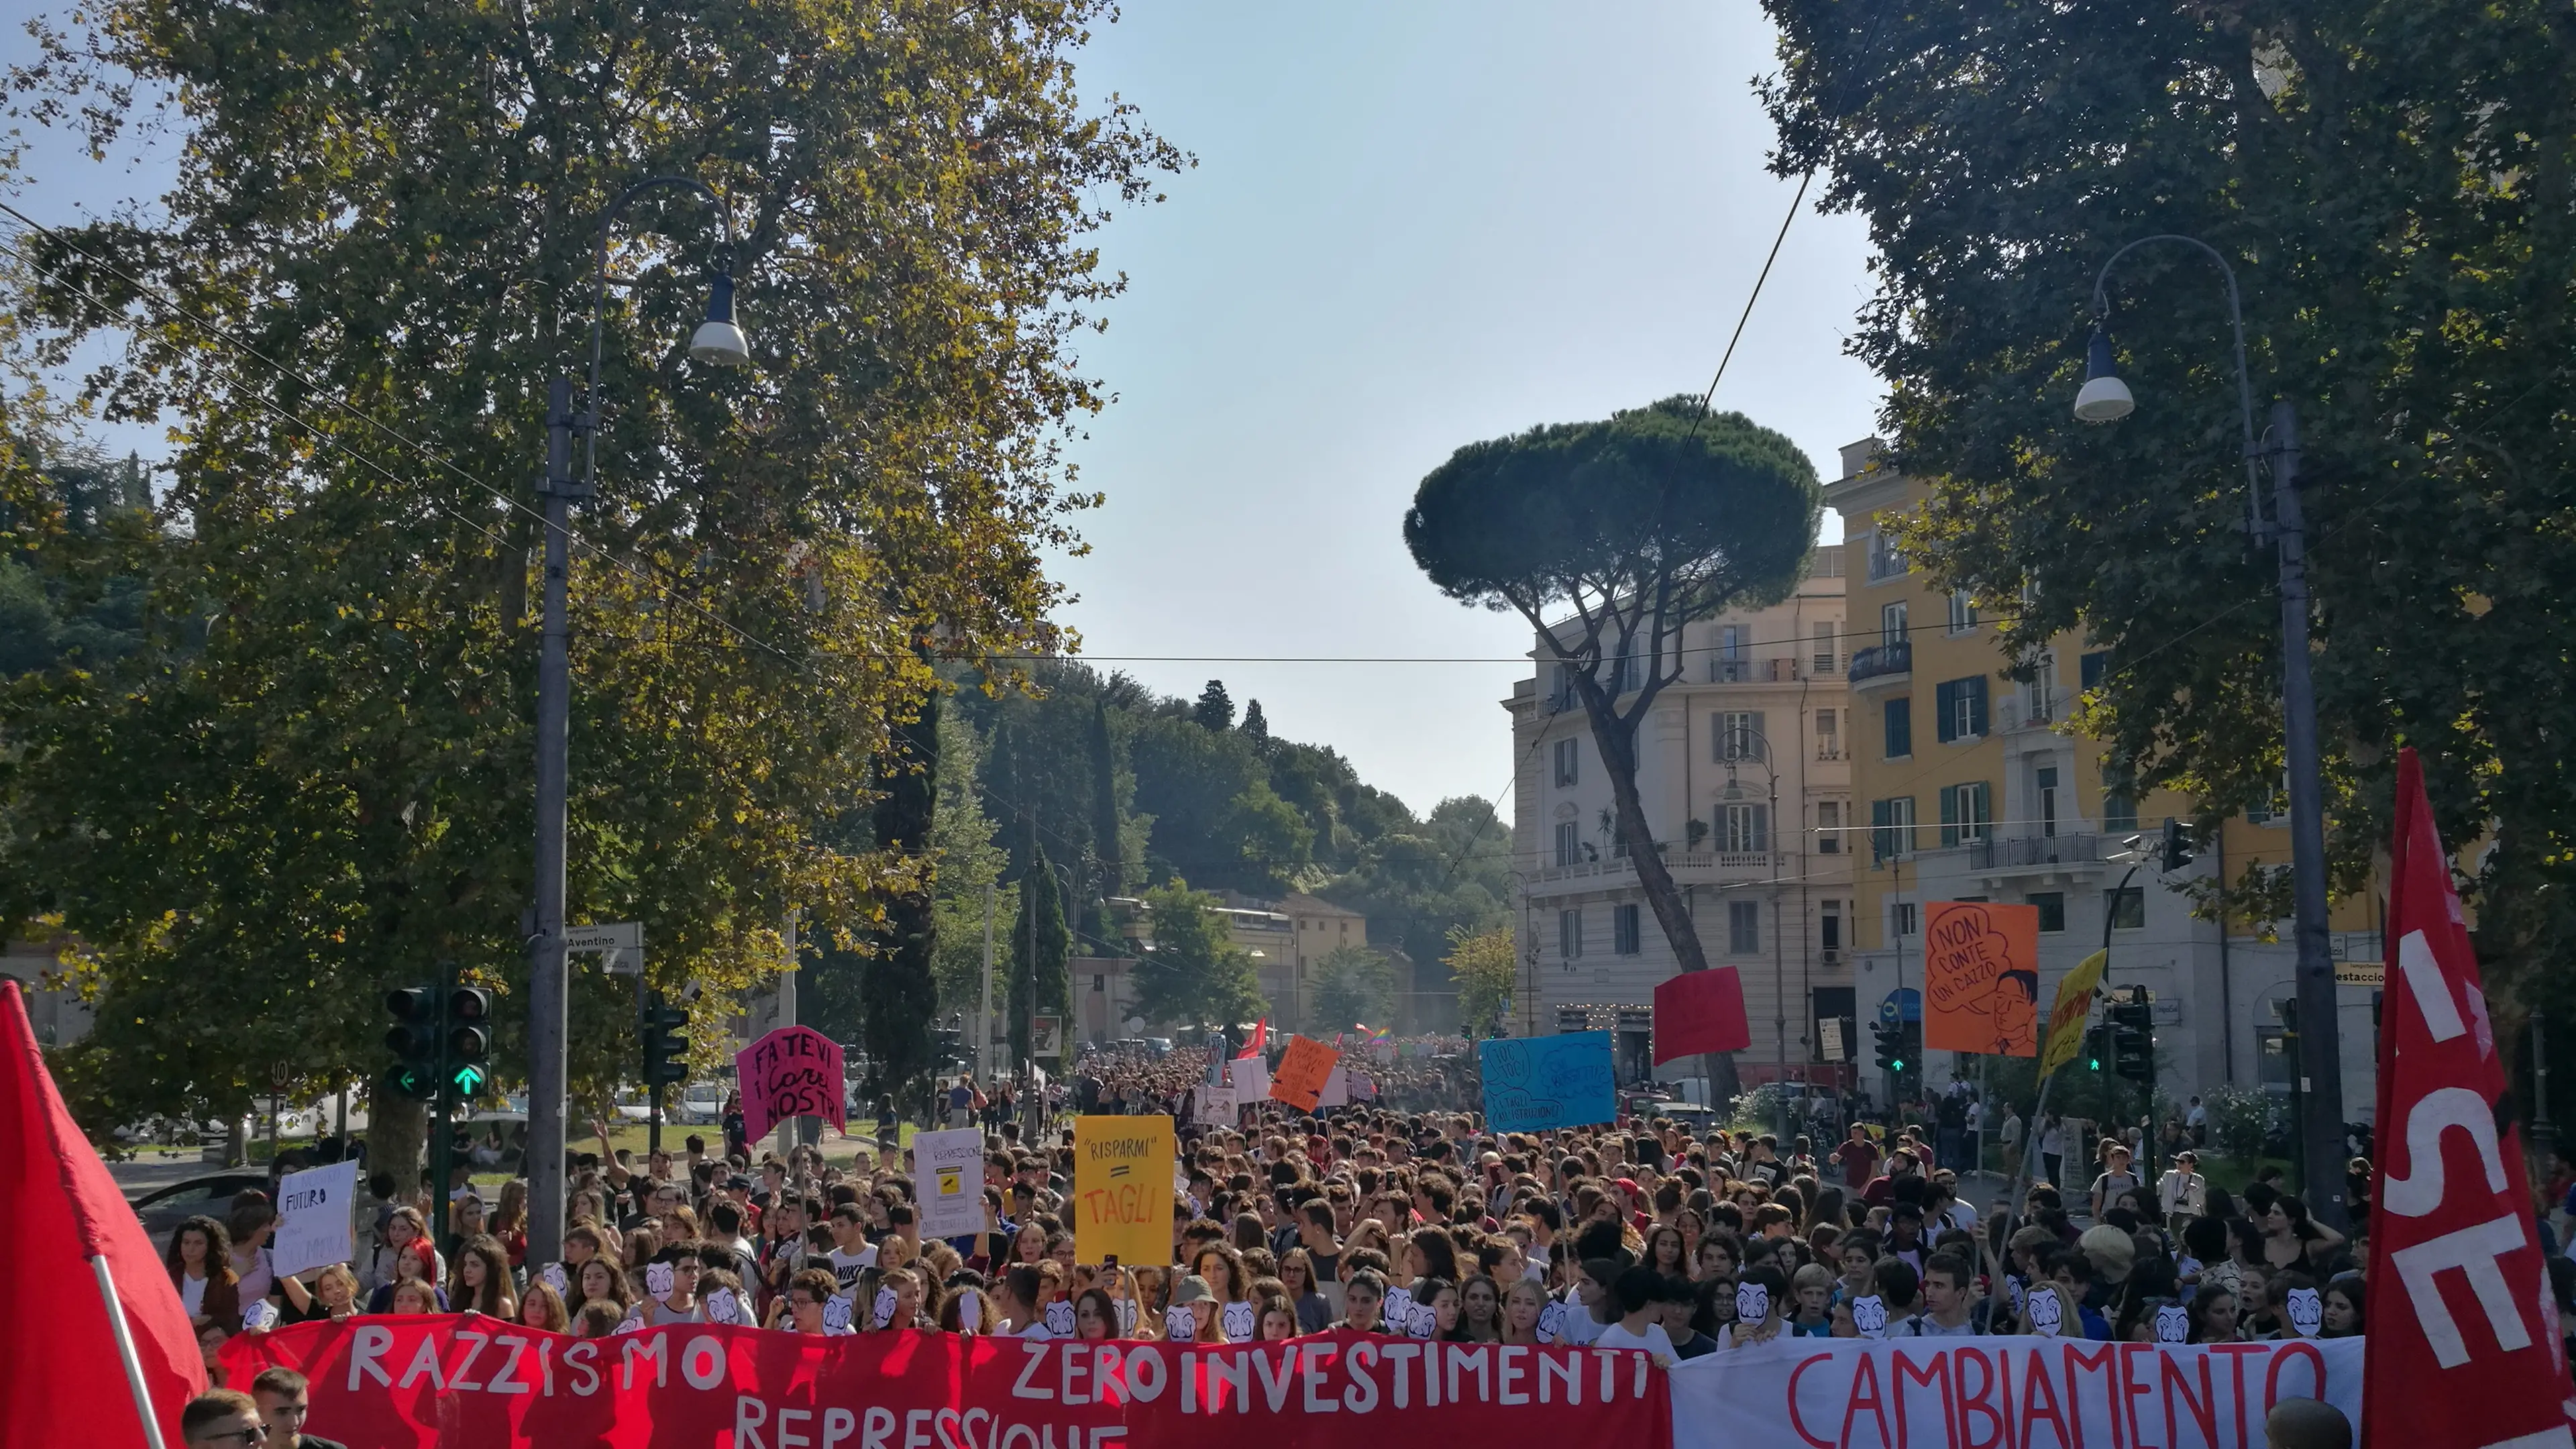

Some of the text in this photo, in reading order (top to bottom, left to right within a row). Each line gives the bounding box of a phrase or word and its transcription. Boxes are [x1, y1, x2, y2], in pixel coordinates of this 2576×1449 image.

[568, 936, 614, 947] Aventino
[1936, 912, 1982, 951] NON
[1938, 941, 1990, 973] CONTE
[1933, 961, 1996, 1002] UN CAZZO
[2336, 972, 2385, 982] estaccio
[755, 1033, 831, 1075] FATEVI
[1493, 1044, 1515, 1063] TOC
[1499, 1060, 1525, 1079] TOC!
[767, 1086, 841, 1132] NOSTRI
[1504, 1095, 1527, 1108] TAGLI
[933, 1143, 983, 1163] REPRESSIONE
[286, 1188, 326, 1212] FUTURO
[1084, 1183, 1157, 1224] TAGLI
[347, 1325, 1647, 1413] RAZZISMO ZERO INVESTIMENTI
[1788, 1342, 2326, 1449] CAMBIAMENTO
